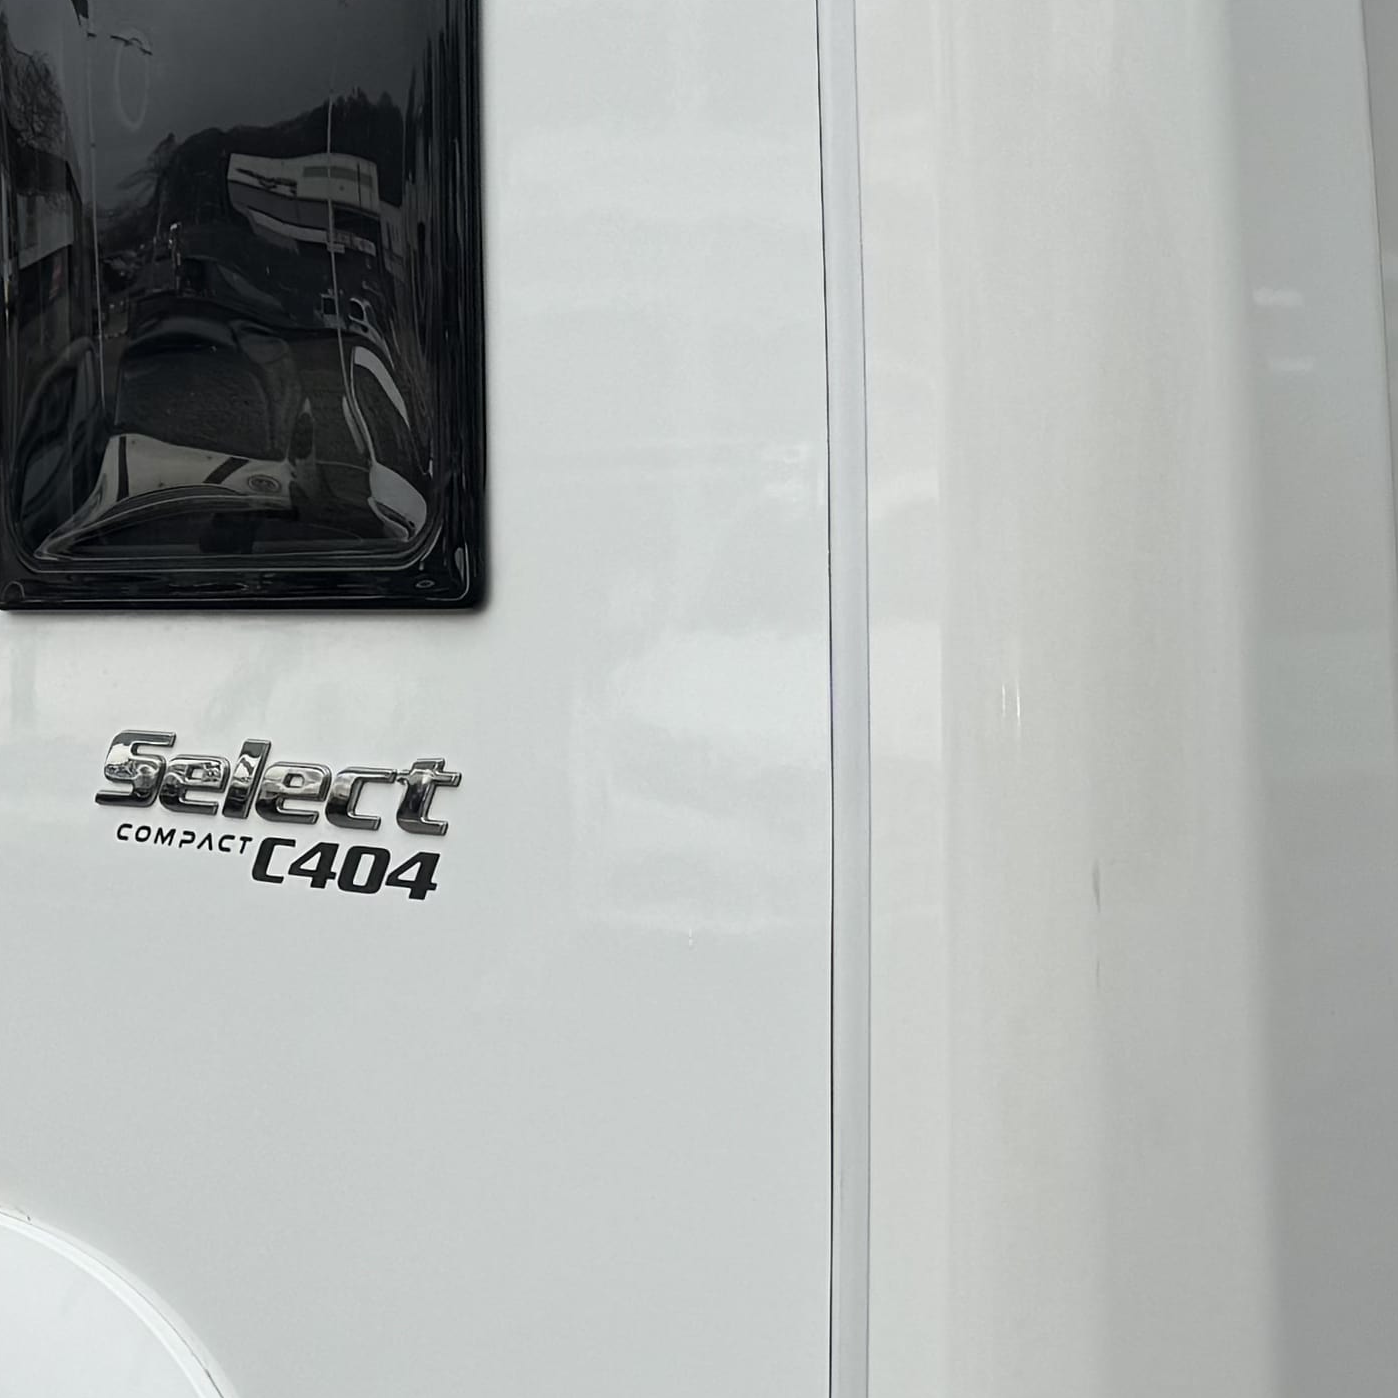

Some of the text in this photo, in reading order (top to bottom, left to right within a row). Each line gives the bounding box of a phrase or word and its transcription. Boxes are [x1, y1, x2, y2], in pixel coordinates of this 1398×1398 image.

[95, 729, 463, 837] Select
[116, 823, 442, 901] COMPACT C404
